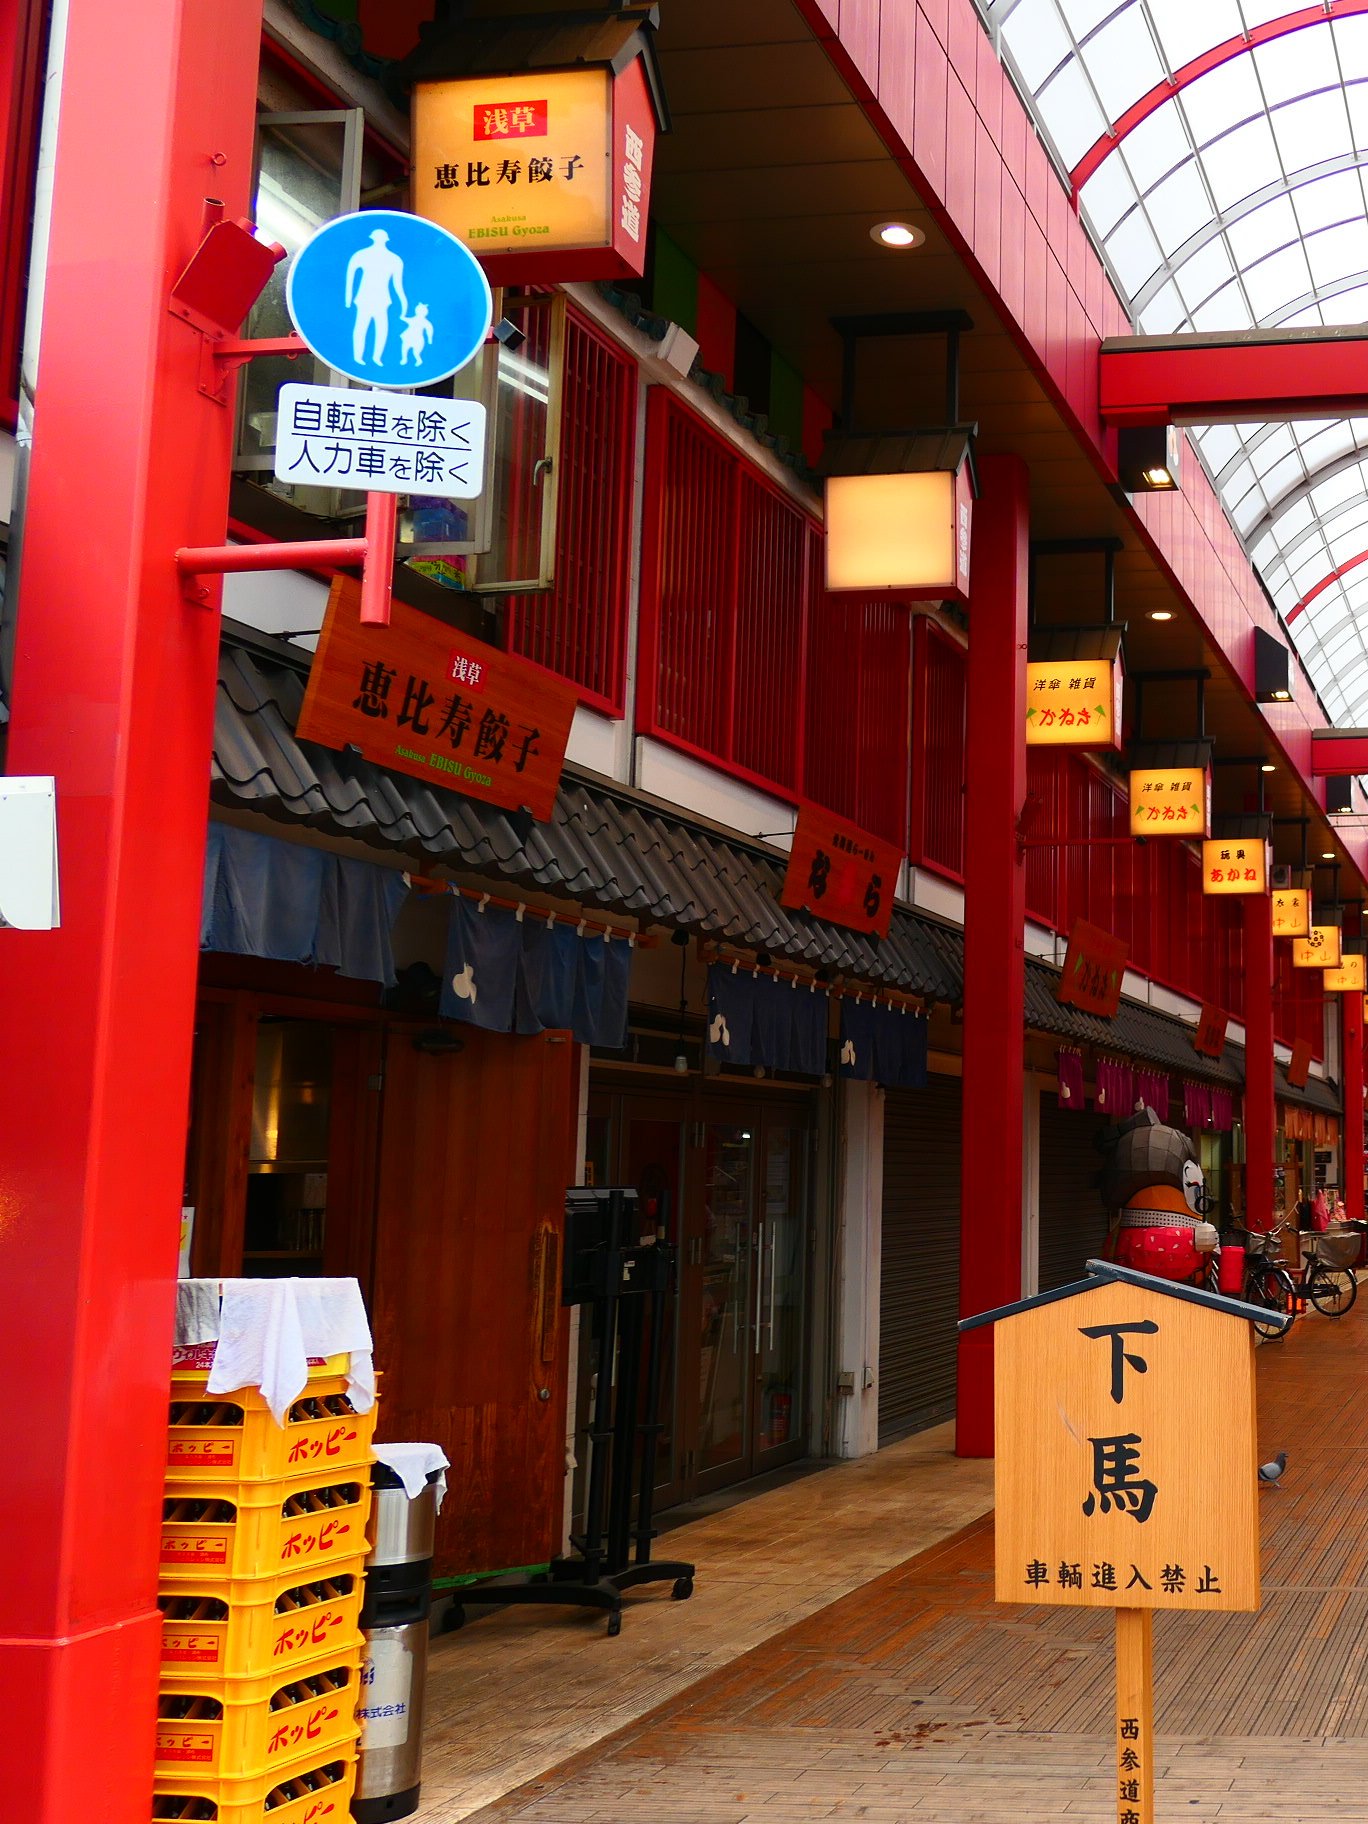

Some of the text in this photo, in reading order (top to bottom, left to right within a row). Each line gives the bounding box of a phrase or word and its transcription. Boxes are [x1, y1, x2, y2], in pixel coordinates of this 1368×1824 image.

[482, 107, 536, 135] 浅草
[433, 155, 585, 189] 恵比寿餃子
[467, 225, 550, 239] EBISU Gyoza
[490, 214, 527, 223] Asakusa
[291, 398, 472, 445] 自転車を除く
[289, 444, 470, 485] 人力車を除く
[451, 655, 484, 686] 浅草
[1033, 677, 1096, 691] 洋傘 雑貨
[352, 660, 541, 773] 恵比寿餃子
[1039, 707, 1091, 727] かねき
[428, 752, 462, 777] EBISU
[463, 766, 493, 787] Gyoza
[1146, 806, 1188, 821] かねき
[1210, 868, 1257, 882] あかね
[174, 1348, 217, 1360] ウィルキ
[1077, 1319, 1159, 1524] 下馬
[172, 1442, 231, 1453] ホッピー
[288, 1426, 357, 1463] ホッピー
[164, 1540, 223, 1550] ホッピー
[281, 1519, 350, 1559] ホッピー
[274, 1611, 343, 1656] ホッピー
[356, 1702, 407, 1720] 株式会社
[267, 1706, 339, 1754] ホッピー
